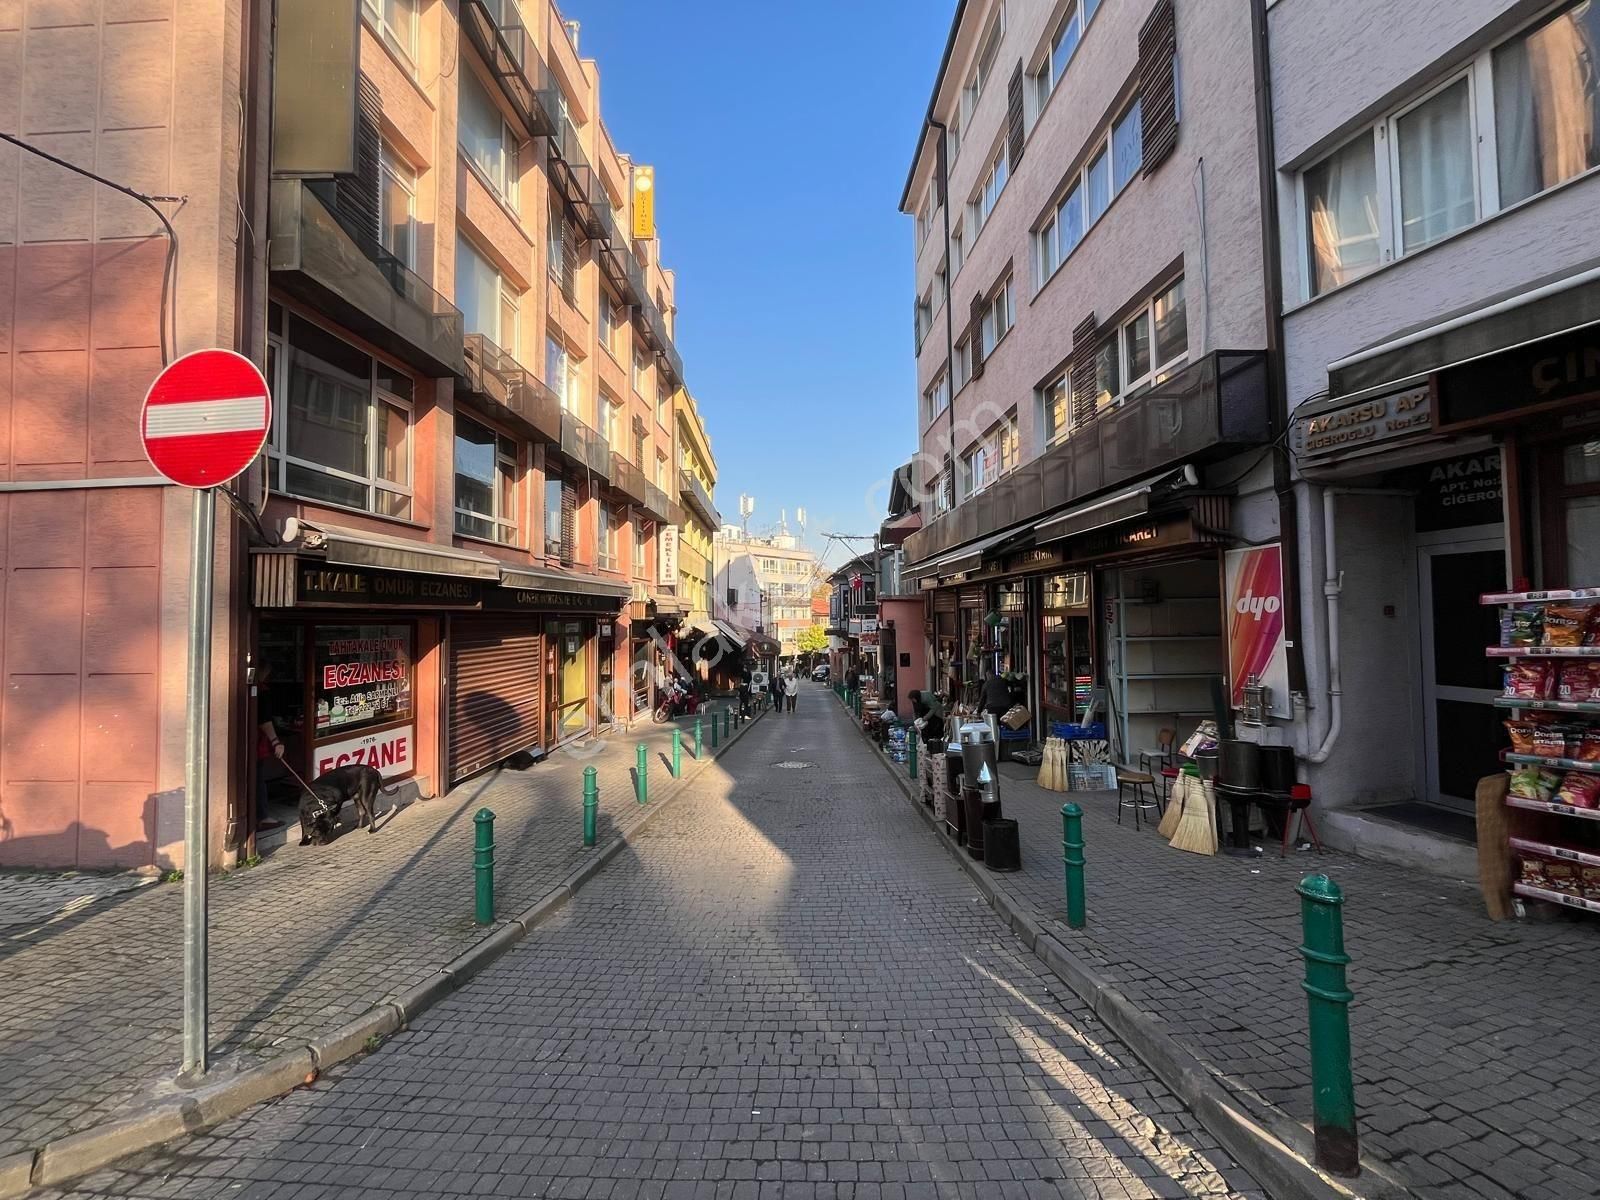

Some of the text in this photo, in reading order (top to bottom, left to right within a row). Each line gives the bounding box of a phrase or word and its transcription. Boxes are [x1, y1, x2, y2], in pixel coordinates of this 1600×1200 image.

[1308, 391, 1430, 434] AKARSU AP
[303, 569, 367, 593] T.KALE
[1236, 588, 1281, 621] dyo
[319, 737, 407, 777] ECZANE
